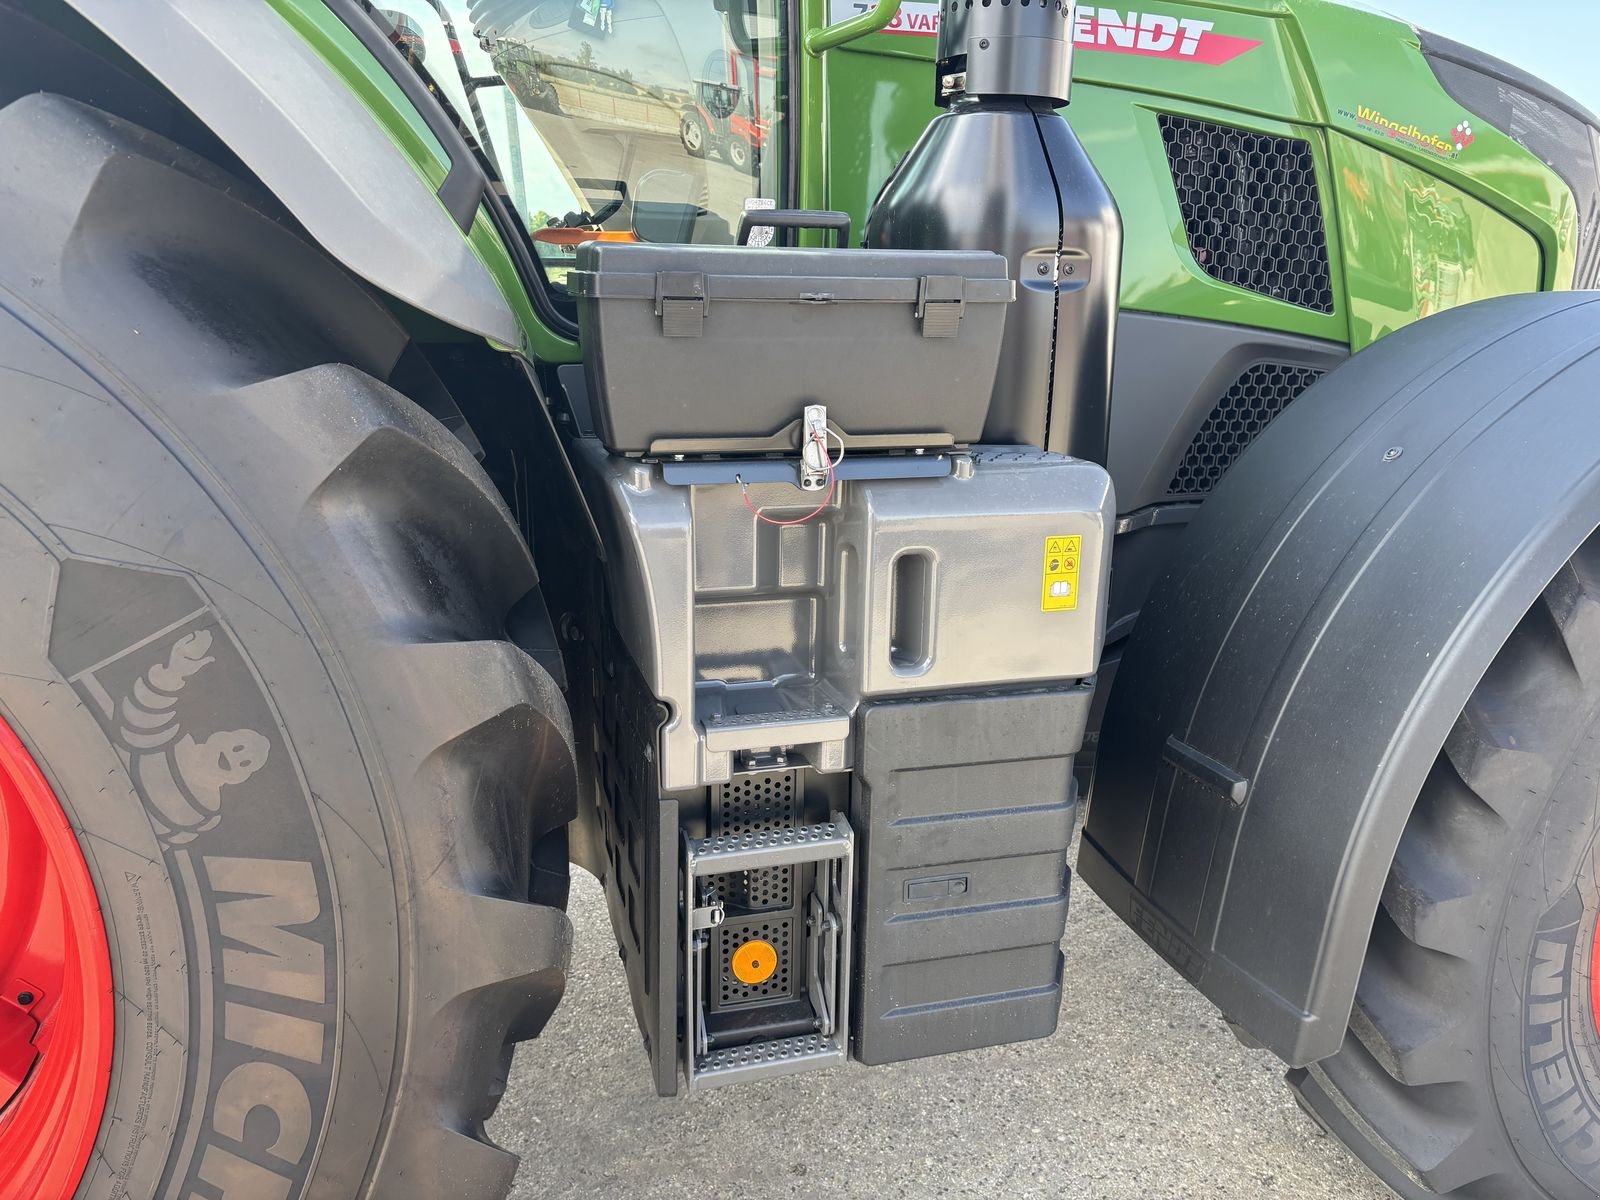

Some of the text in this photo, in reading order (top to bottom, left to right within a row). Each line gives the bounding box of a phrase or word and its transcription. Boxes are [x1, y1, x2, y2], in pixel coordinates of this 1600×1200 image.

[906, 13, 939, 31] VAR
[1073, 5, 1214, 55] ENDT
[1528, 939, 1600, 1191] CHELIN
